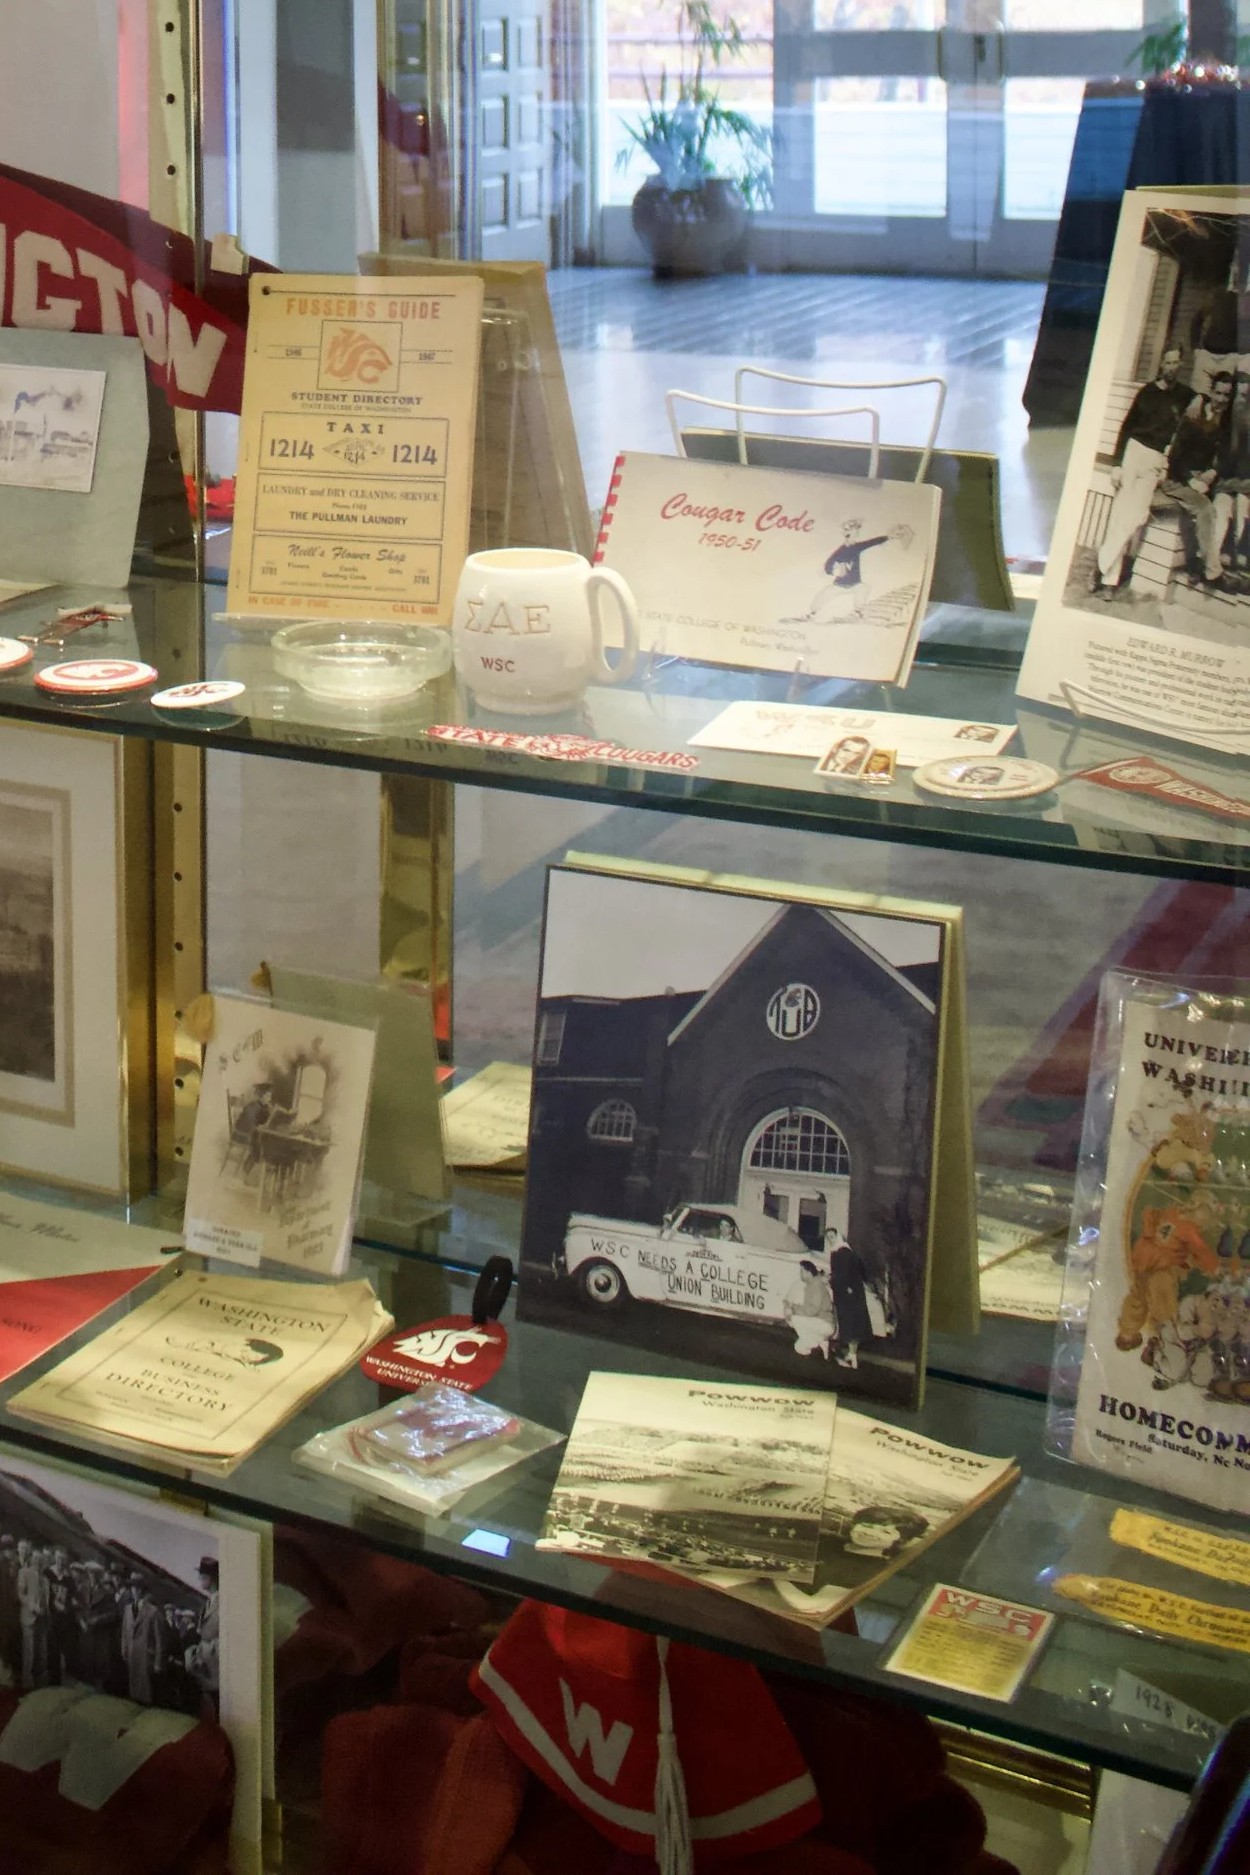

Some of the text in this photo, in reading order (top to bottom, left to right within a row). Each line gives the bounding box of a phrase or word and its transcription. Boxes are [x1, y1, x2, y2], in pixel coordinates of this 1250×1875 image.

[286, 297, 442, 320] FUSSER'S GUIDE
[291, 391, 423, 406] STUDENT DIRECTORY
[326, 421, 386, 435] TAXI
[269, 438, 315, 461] 1214
[392, 444, 438, 466] 1214
[262, 484, 440, 502] LAUNDRY and DRY CLEANING SERVICE
[289, 511, 408, 526] THE PULLMAN LAUNDRY
[659, 492, 817, 534] Cougar Code
[331, 546, 372, 561] Flower
[376, 548, 407, 563] Shop
[698, 531, 762, 552] 1950-51
[392, 604, 416, 614] CALL
[645, 610, 672, 623] STATE
[676, 614, 721, 630] COLLEGE
[724, 621, 739, 631] OF
[743, 625, 807, 641] WASHINGTON
[480, 656, 516, 675] WSC
[591, 740, 699, 769] COUGARS
[590, 1238, 630, 1258] WSC
[637, 1249, 677, 1271] NEEDS
[685, 1260, 694, 1275] A
[700, 1262, 769, 1292] COLLEGE
[667, 1273, 766, 1311] UNION BUILDING
[199, 1295, 329, 1333] WASHINGTON
[219, 1315, 282, 1336] STATE
[160, 1355, 236, 1382] COLLEGE
[366, 1355, 474, 1391] WASHINGTON STATE
[105, 1371, 233, 1412] DIRECTORY
[141, 1368, 221, 1397] BUSINESS
[701, 1399, 815, 1415] Washington State
[1095, 1428, 1126, 1446] Rogers
[1129, 1439, 1153, 1455] Field
[1147, 1432, 1209, 1464] Saturday,
[945, 1592, 1033, 1625] WSC
[558, 1677, 634, 1786] W
